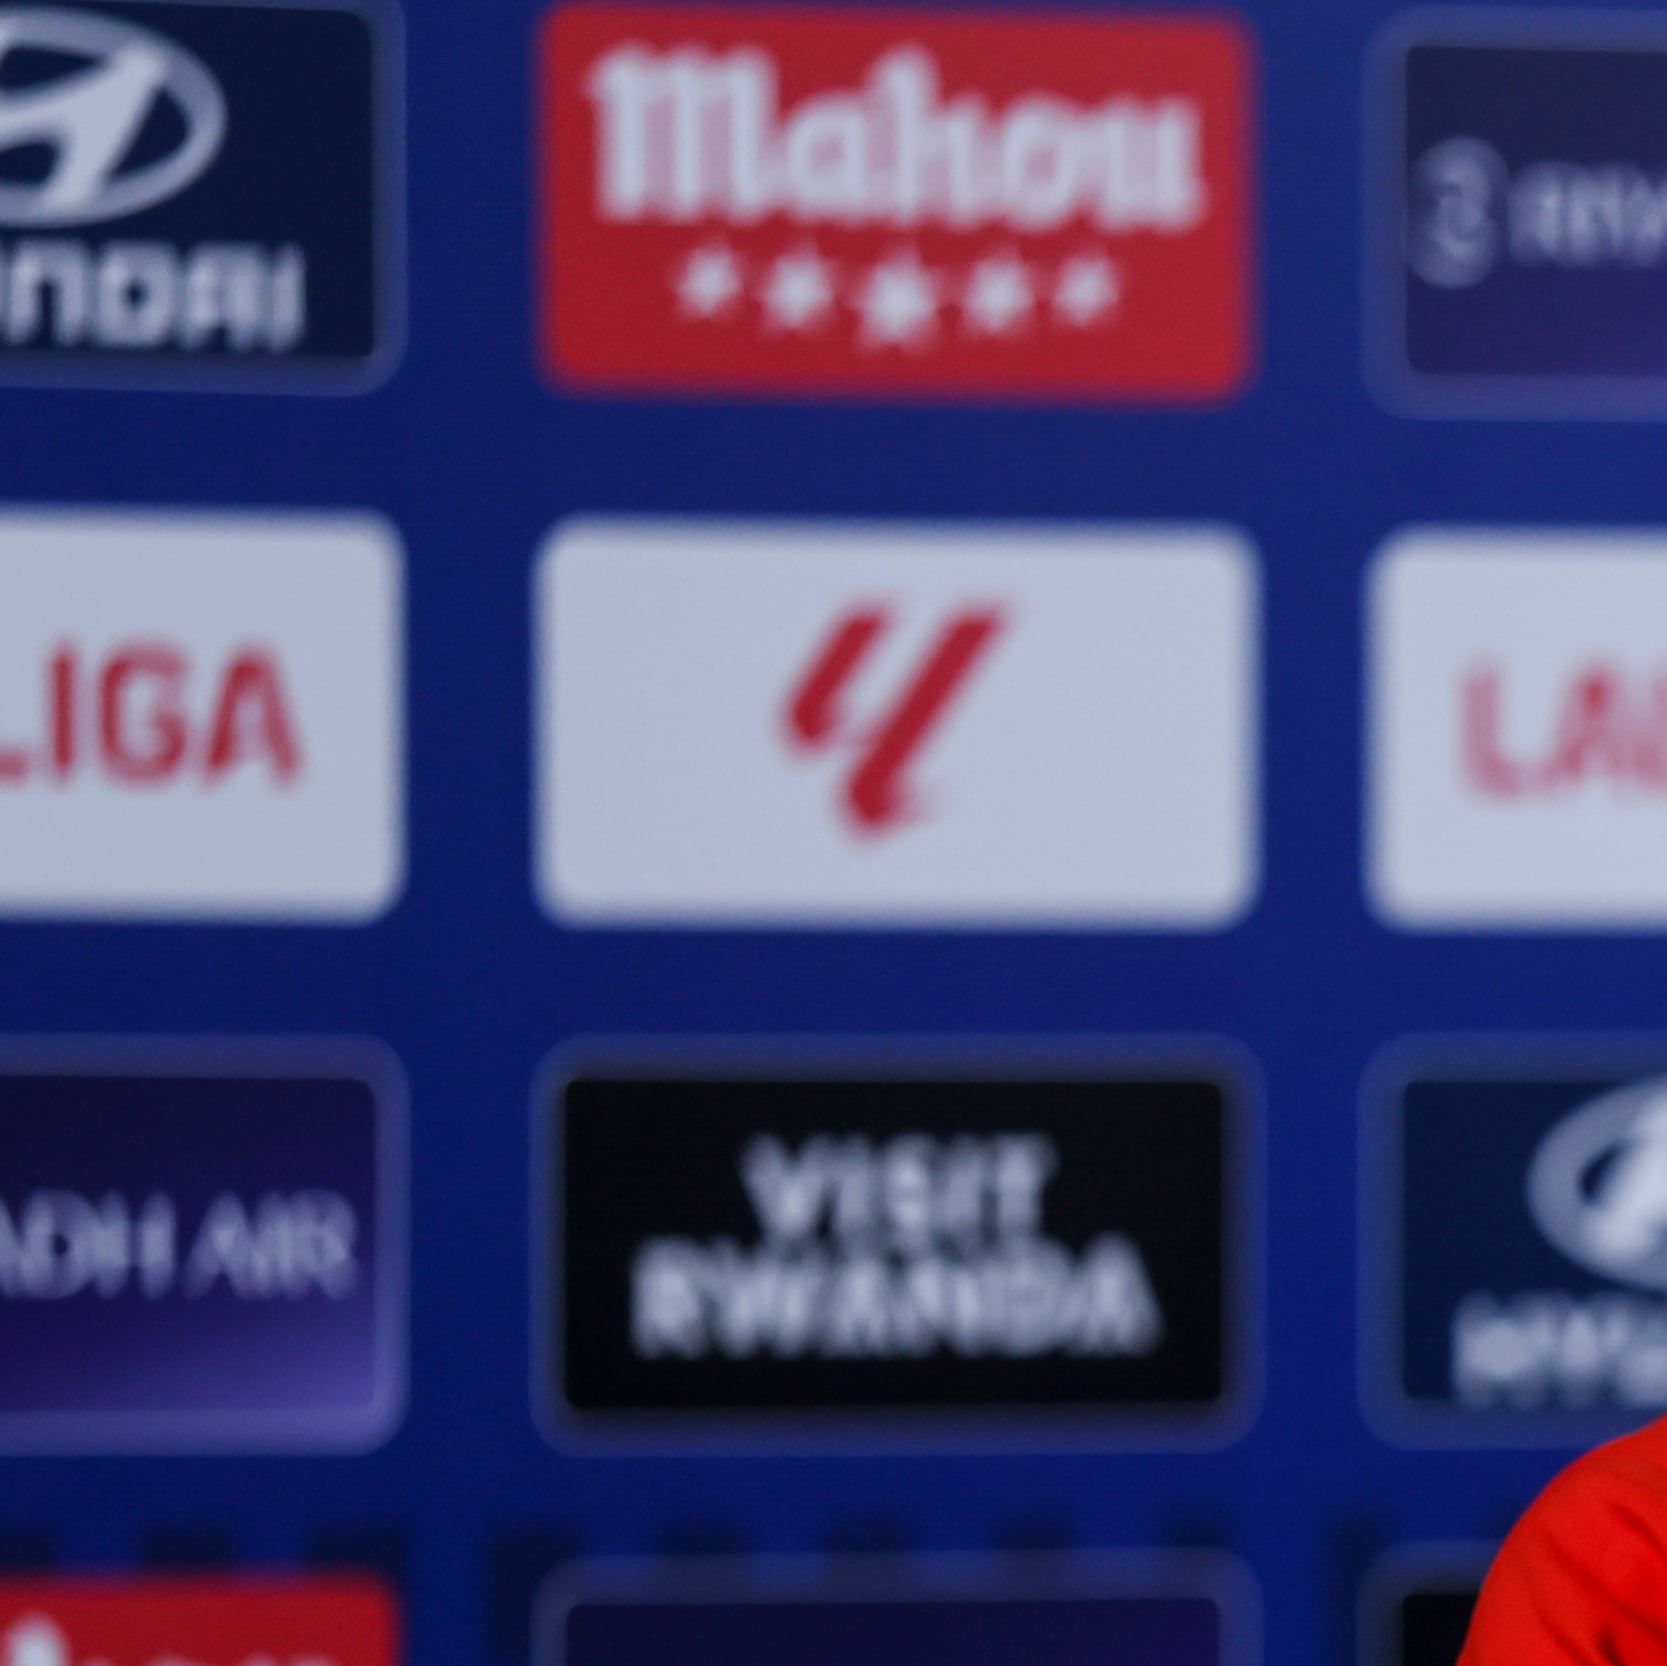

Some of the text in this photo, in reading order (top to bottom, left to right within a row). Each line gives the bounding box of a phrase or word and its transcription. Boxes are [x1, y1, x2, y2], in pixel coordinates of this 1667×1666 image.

[588, 44, 1207, 230] Mahou
[0, 640, 303, 788] IGA
[744, 1136, 1052, 1243] VISIT
[632, 1236, 1158, 1354] RWANDA
